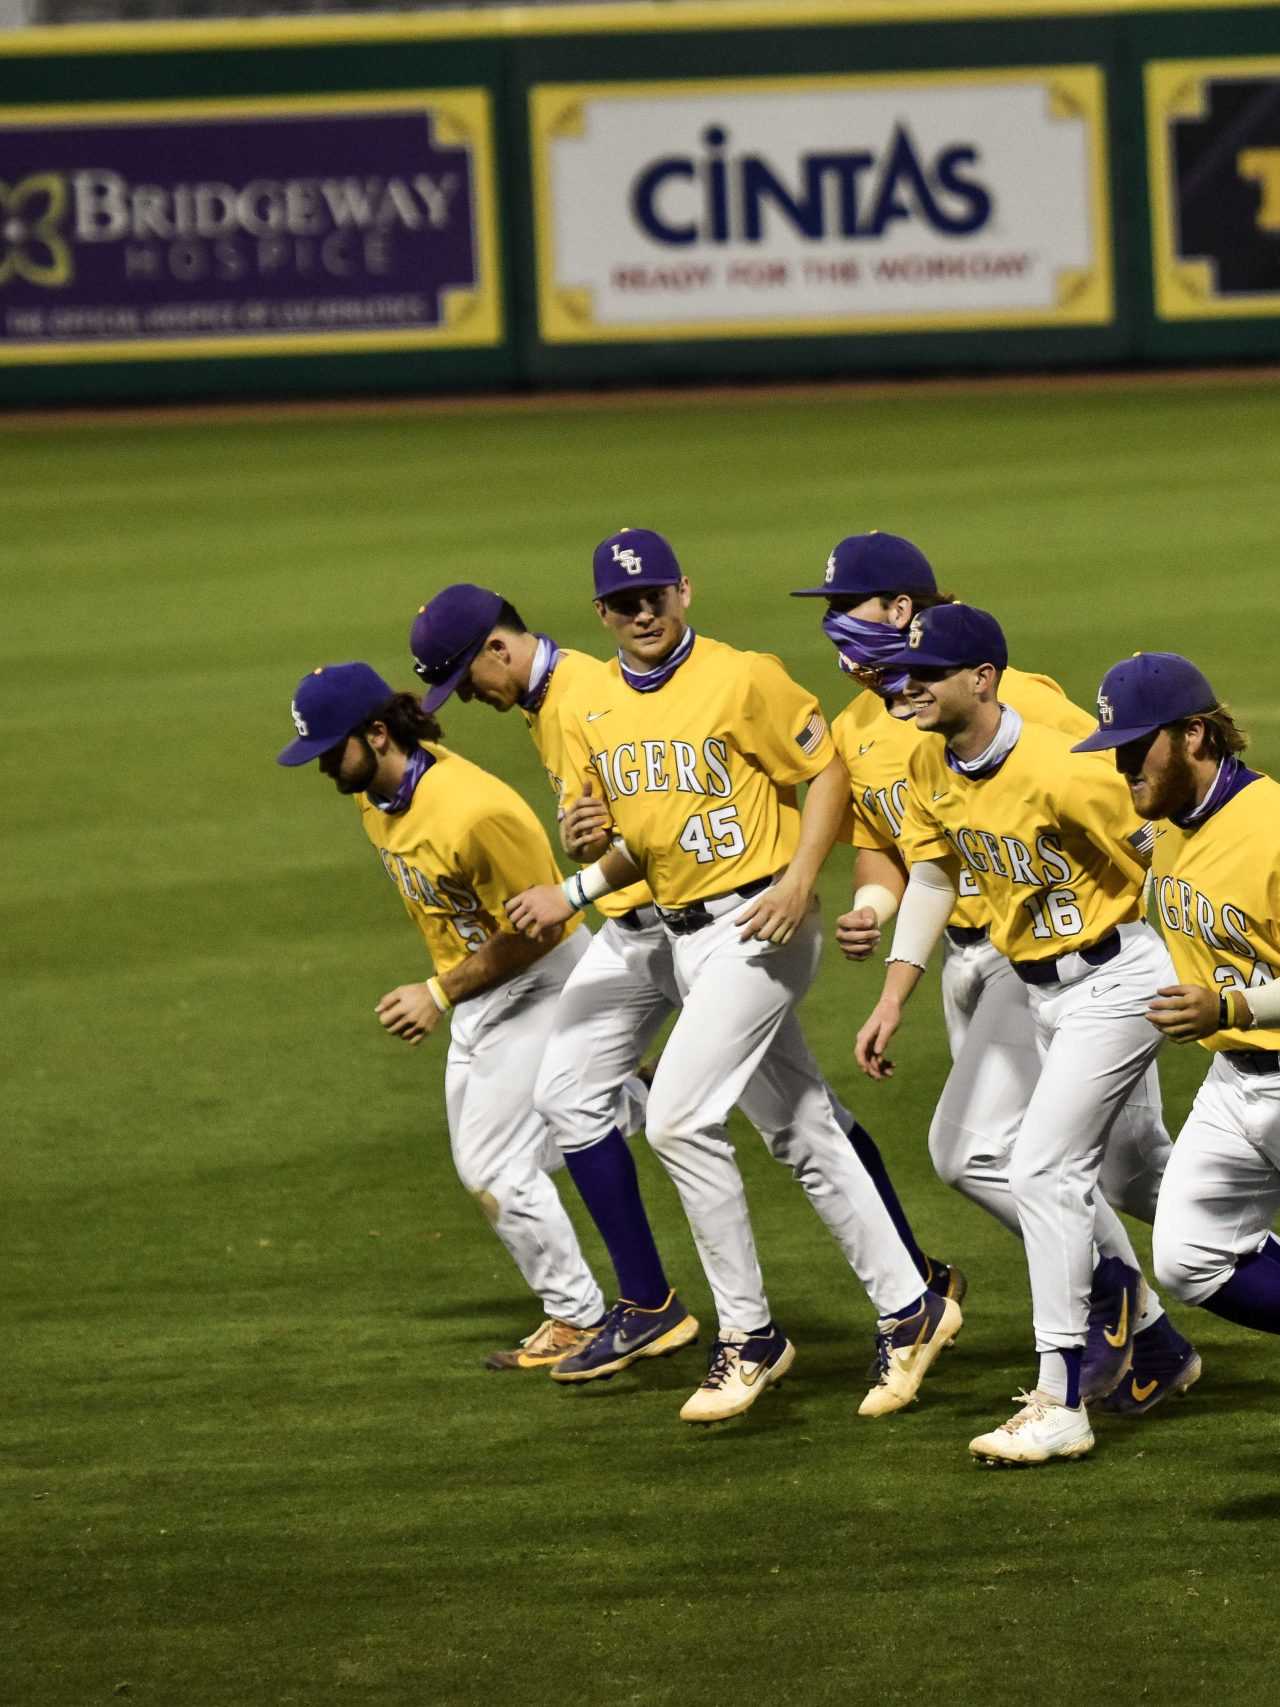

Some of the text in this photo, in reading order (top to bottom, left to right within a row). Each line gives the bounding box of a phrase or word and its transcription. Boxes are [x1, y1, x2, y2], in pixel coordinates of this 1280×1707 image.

[72, 168, 458, 243] BRIDGEWAY
[124, 227, 392, 281] HOSPICE
[609, 252, 1032, 293] READY FOR THE WORKDAY
[612, 544, 642, 575] LSU
[590, 736, 733, 801] IGERS
[679, 805, 746, 864] 45
[1023, 888, 1084, 939] 16
